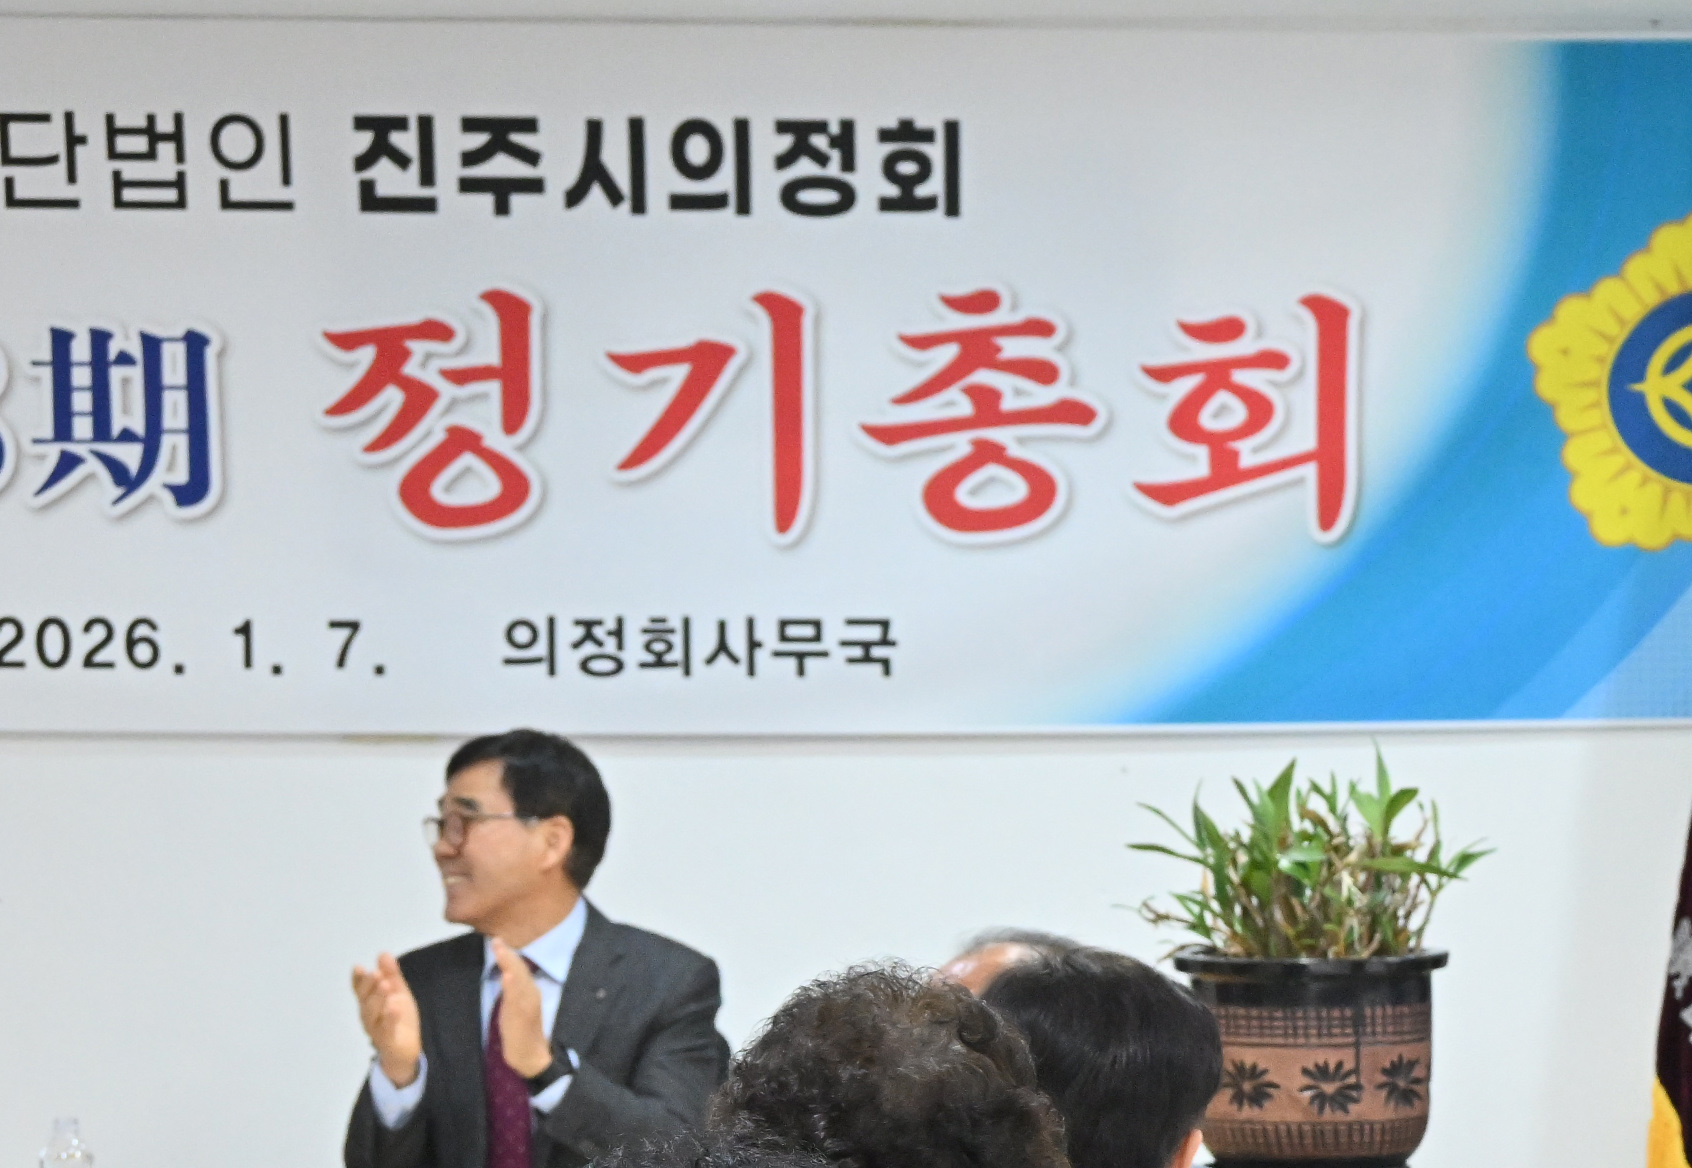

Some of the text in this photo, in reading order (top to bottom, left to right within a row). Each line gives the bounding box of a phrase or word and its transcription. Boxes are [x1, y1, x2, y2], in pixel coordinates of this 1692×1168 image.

[0, 111, 959, 216] 단법인 진주시의정회
[0, 290, 1350, 533] 期 정기총회
[0, 618, 895, 676] 2026. 1. 7. 의정회사무국
